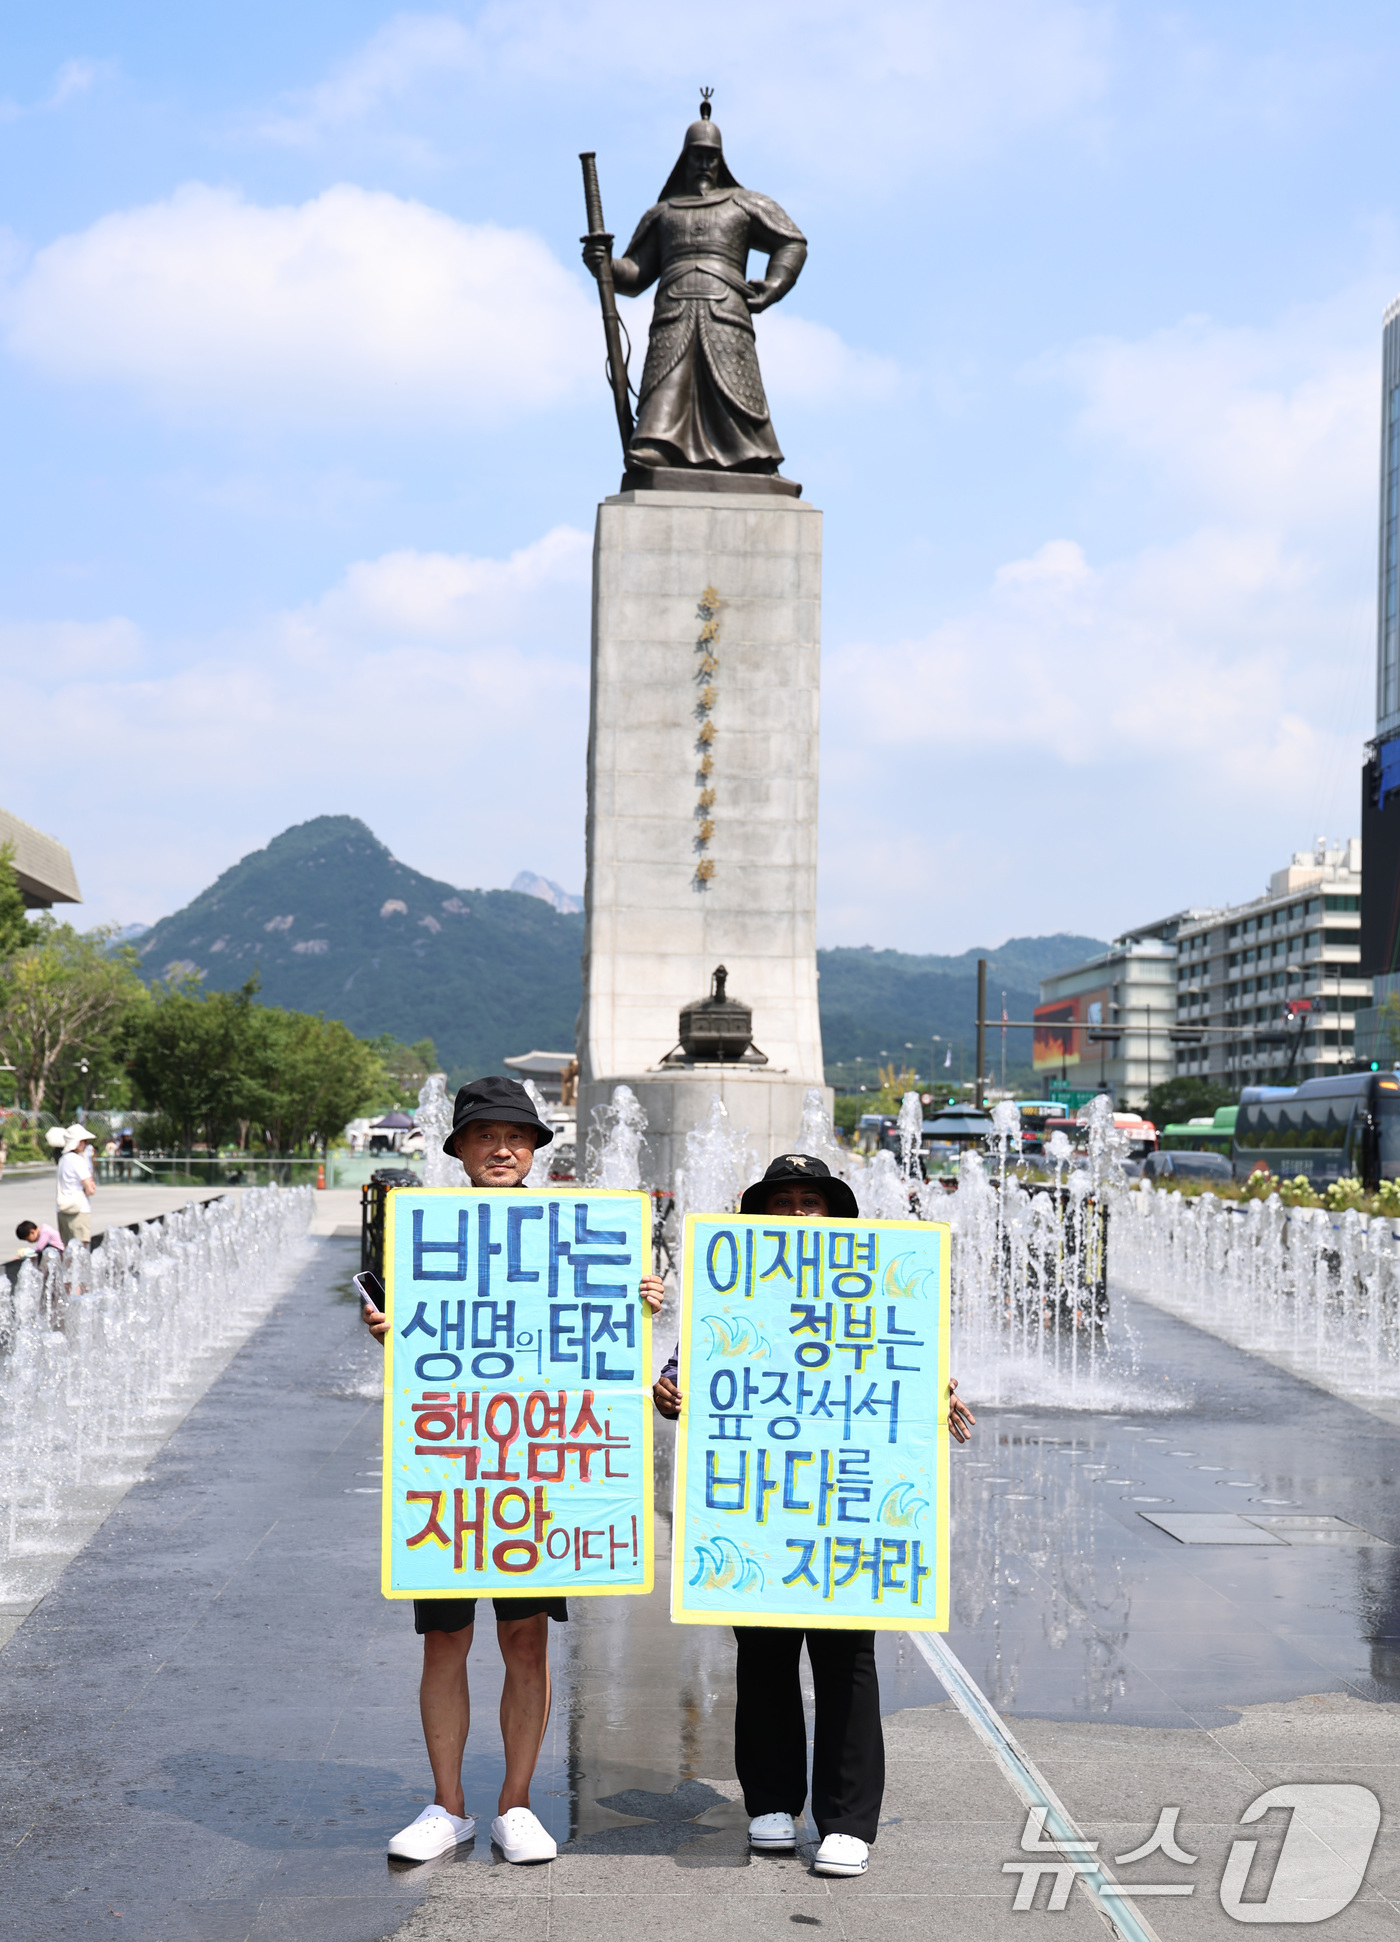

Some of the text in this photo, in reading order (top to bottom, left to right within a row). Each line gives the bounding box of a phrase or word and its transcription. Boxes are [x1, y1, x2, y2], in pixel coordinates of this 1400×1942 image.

[412, 1202, 631, 1298] 바다는
[706, 1228, 879, 1299] 이재명
[401, 1300, 635, 1380] 생명의 터전
[788, 1303, 924, 1371] 정부는
[411, 1389, 631, 1482] 핵오염수는
[708, 1367, 901, 1443] 앞장서서
[706, 1449, 874, 1526] 바다를
[406, 1486, 638, 1574] 재앙이다!
[782, 1537, 930, 1604] 지켜라
